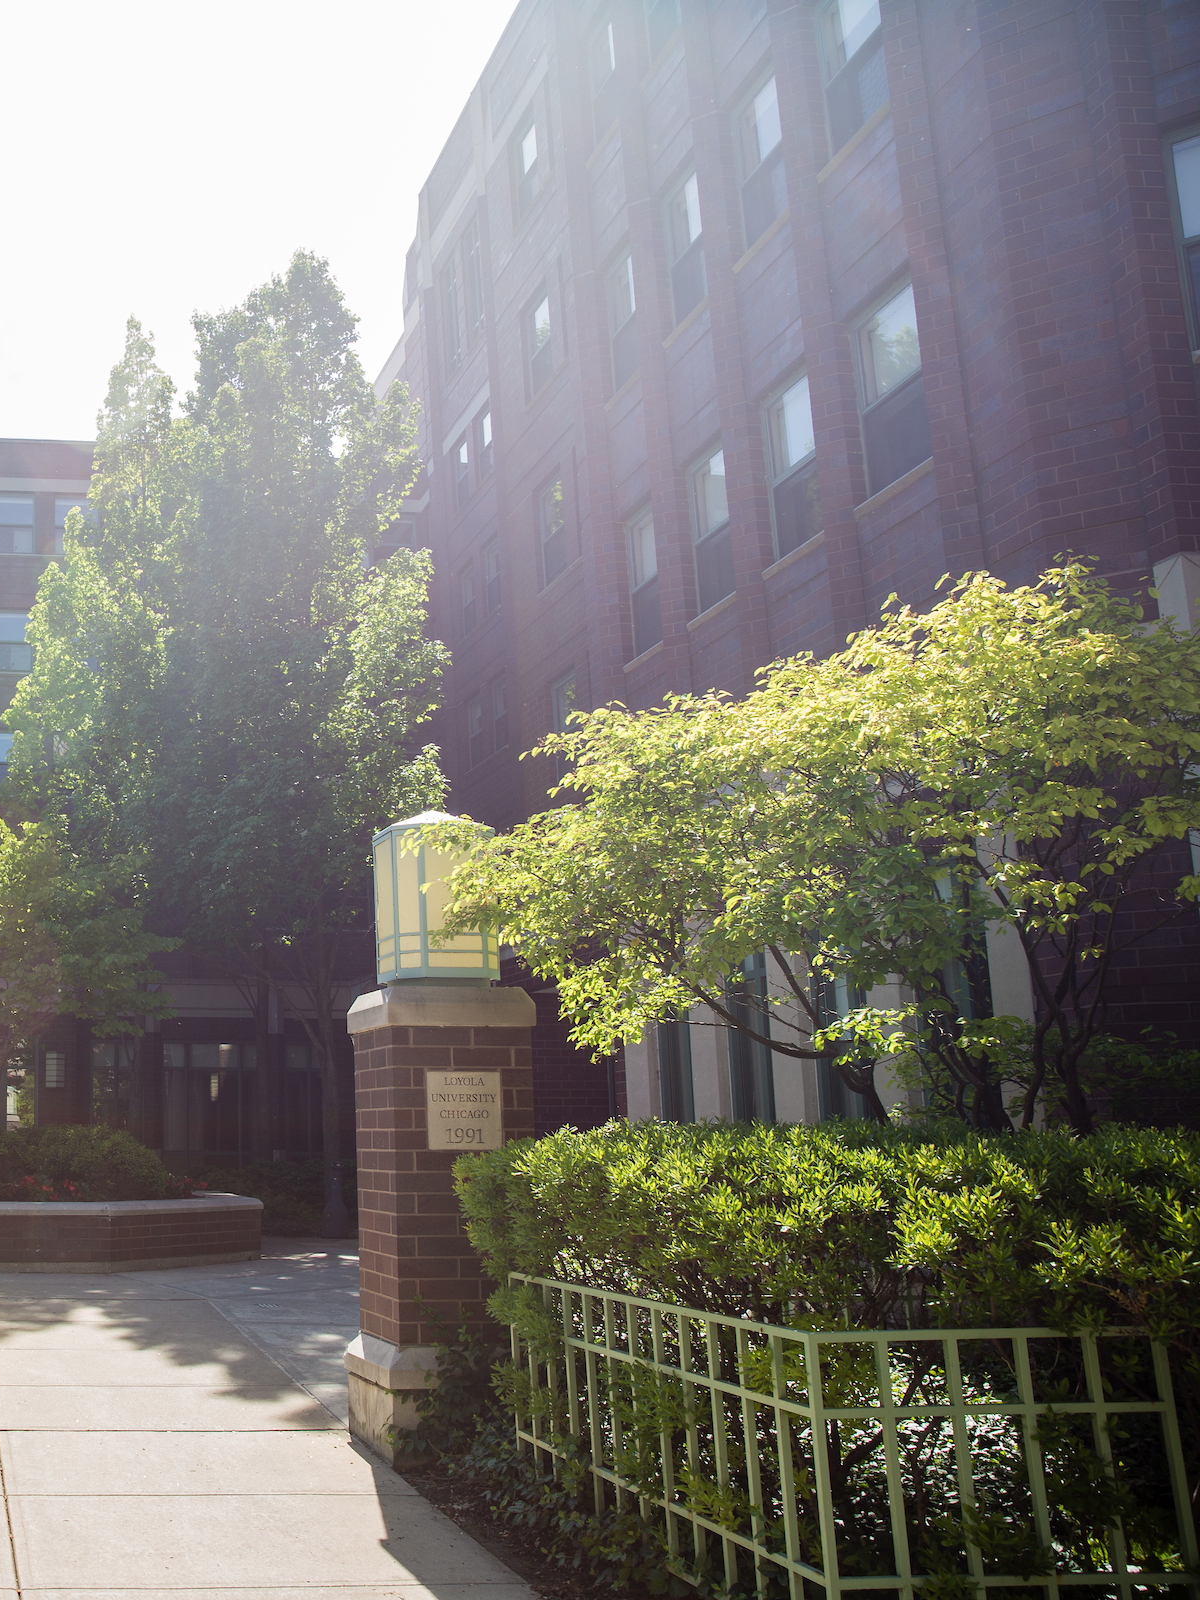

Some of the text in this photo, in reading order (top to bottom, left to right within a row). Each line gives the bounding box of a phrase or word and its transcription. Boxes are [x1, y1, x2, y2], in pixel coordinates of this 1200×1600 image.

[444, 1077, 485, 1086] LOYOLA
[431, 1093, 497, 1103] UNIVERSITY
[439, 1109, 489, 1119] CHICAGO
[445, 1127, 485, 1144] 1991
